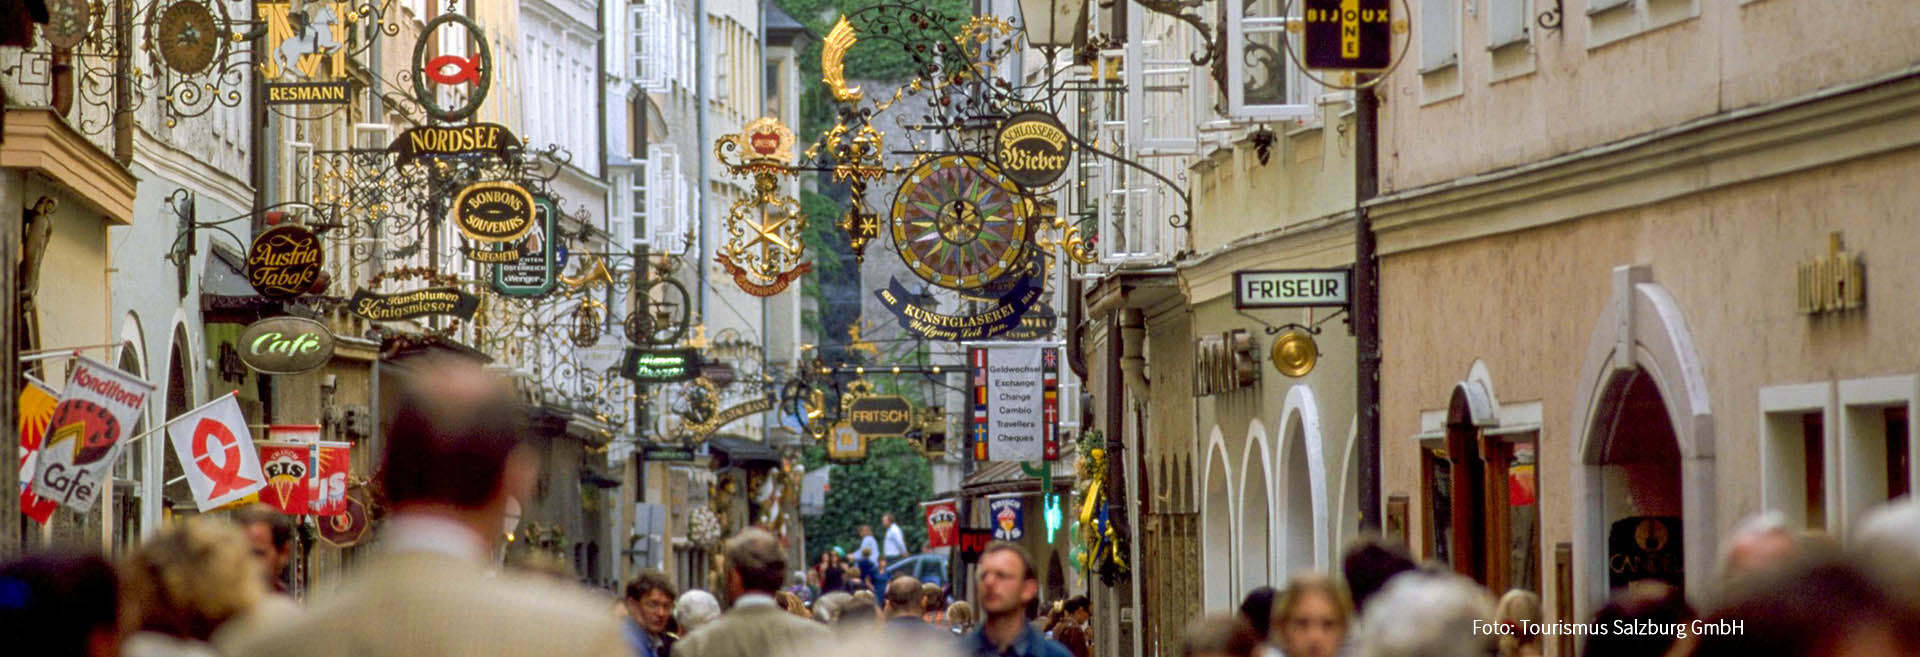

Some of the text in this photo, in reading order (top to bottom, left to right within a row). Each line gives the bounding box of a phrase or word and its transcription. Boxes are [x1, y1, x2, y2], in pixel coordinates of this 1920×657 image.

[1307, 9, 1388, 22] BIJOUX
[270, 86, 344, 100] RESMANN
[410, 127, 500, 153] NORDSEE
[1003, 124, 1065, 144] SCHLOSSEREI
[1000, 147, 1065, 170] Wieber
[466, 215, 524, 233] SOUVENIRS
[249, 238, 318, 266] Austria
[252, 263, 314, 289] Tabak
[388, 290, 459, 305] Kunstblumen
[1248, 279, 1339, 299] FRISEUR
[904, 303, 1015, 328] KUNSTGLASEREI
[250, 333, 321, 357] Café
[989, 365, 1041, 373] Geldwechsel
[72, 366, 145, 409] Konditorei
[994, 380, 1035, 388] Exchange
[999, 393, 1031, 402] Change
[853, 409, 909, 422] FRITSCH
[999, 406, 1032, 415] Cambio
[996, 420, 1035, 429] Travellers
[996, 434, 1035, 443] Cheques
[265, 462, 304, 480] EIS
[43, 463, 96, 503] Café
